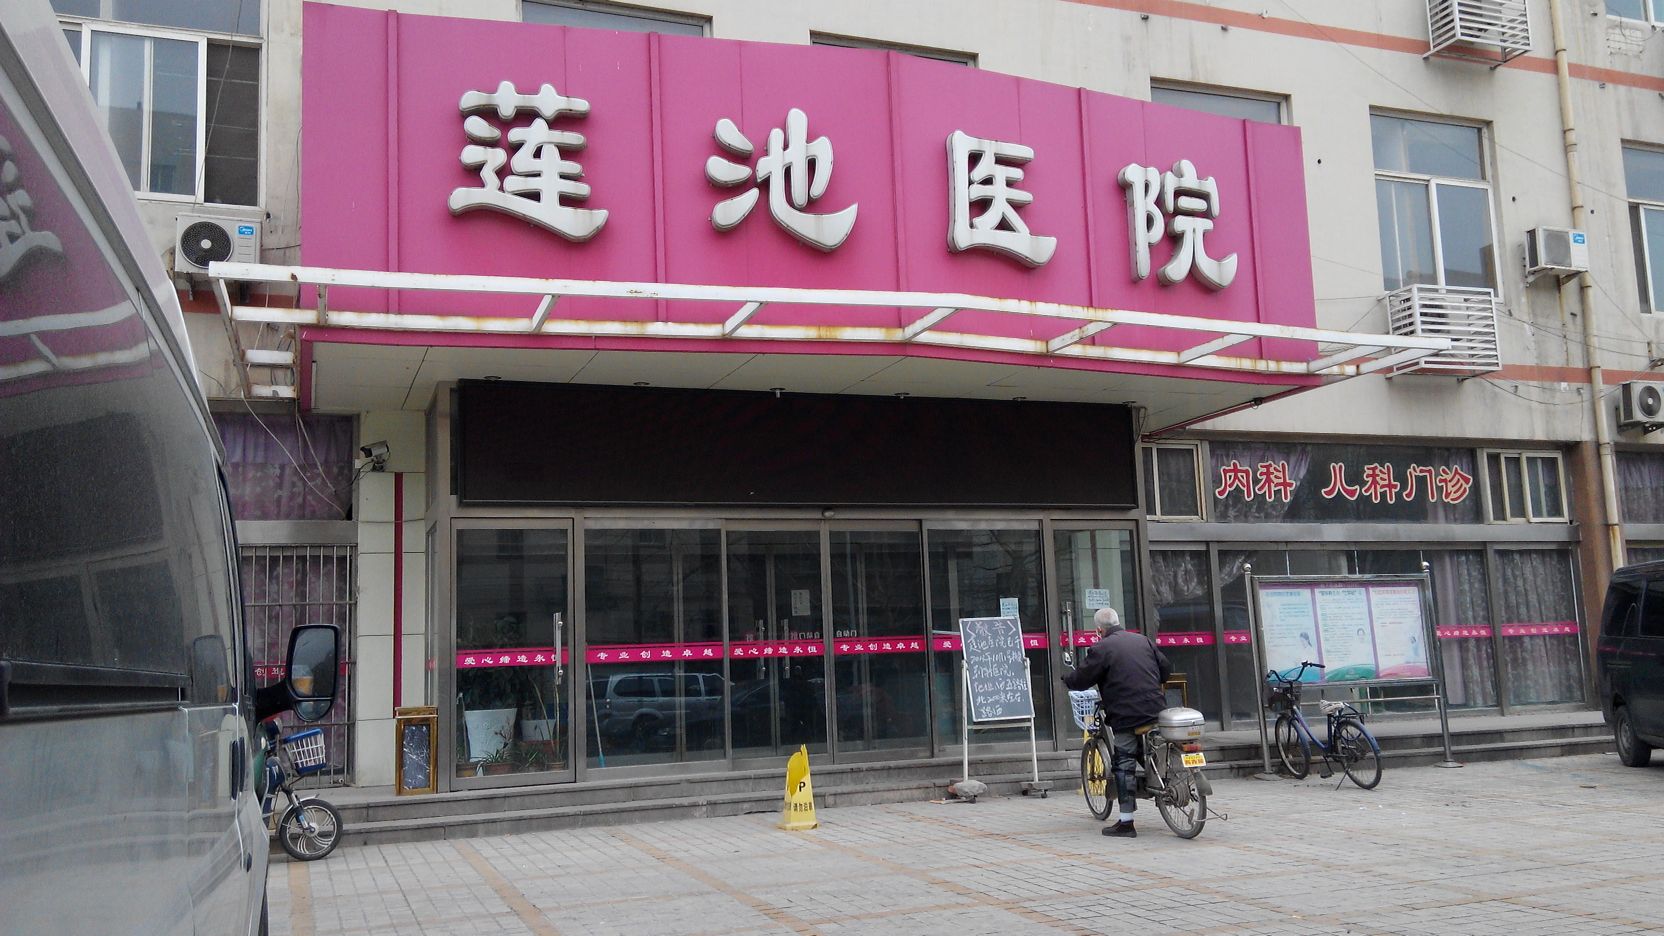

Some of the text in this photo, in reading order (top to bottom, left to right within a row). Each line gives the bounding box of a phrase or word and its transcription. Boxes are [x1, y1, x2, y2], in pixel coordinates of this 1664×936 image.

[447, 81, 1238, 291] 莲池医院
[1216, 461, 1472, 503] 内科 儿科门诊
[733, 645, 818, 656] 爱心缔造永恒
[840, 641, 920, 651] 专业创造卓越
[597, 648, 714, 660] 专业创造卓越
[799, 781, 806, 792] P
